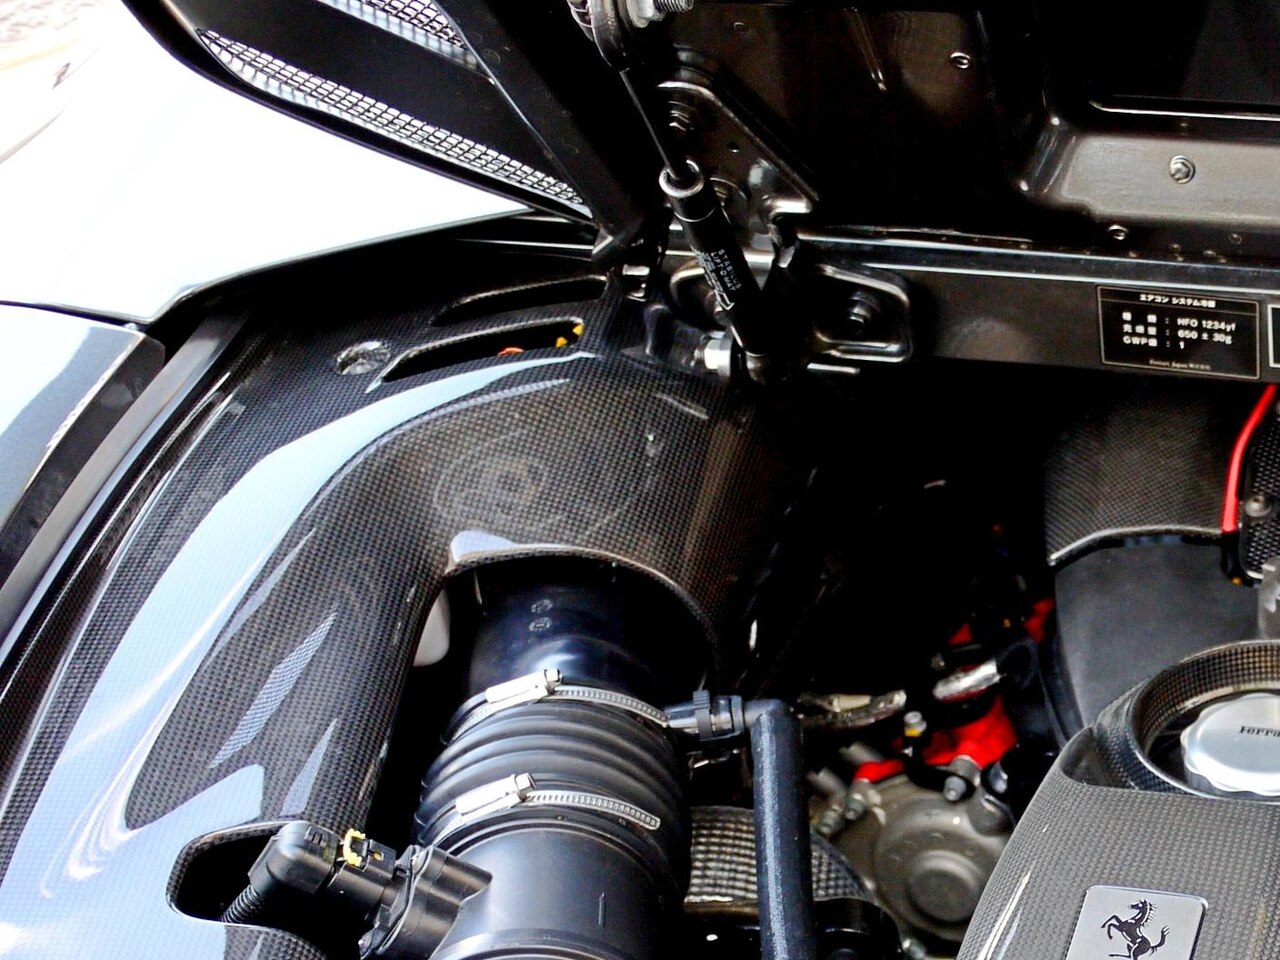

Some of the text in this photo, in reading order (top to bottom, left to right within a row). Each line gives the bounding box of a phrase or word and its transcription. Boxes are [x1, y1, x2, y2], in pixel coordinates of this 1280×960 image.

[718, 249, 742, 289] STABILUS
[1177, 317, 1198, 328] HFO
[1201, 319, 1236, 332] 1234yf
[1177, 329, 1198, 339] 650
[1212, 332, 1233, 345] 30g
[1179, 340, 1185, 349] 1
